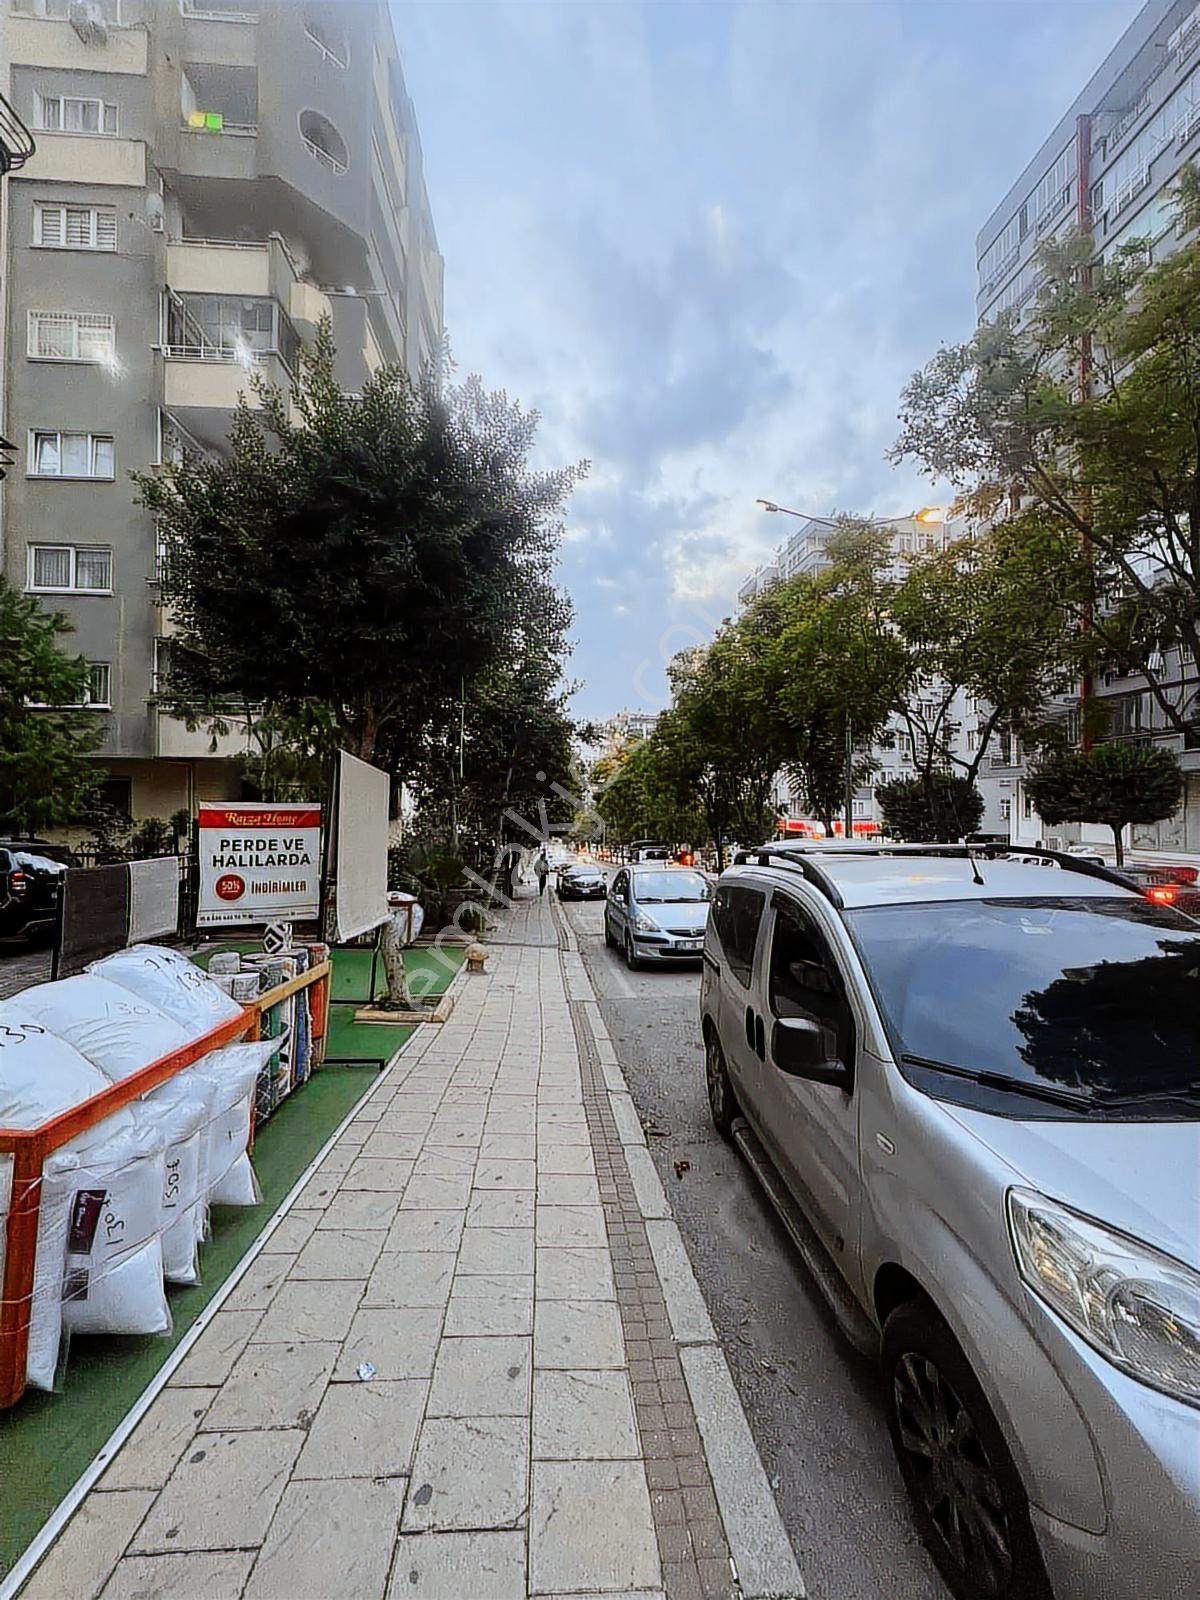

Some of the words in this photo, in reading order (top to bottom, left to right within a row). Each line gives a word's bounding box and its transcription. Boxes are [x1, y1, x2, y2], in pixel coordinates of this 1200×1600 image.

[220, 839, 278, 852] PERDE
[283, 838, 304, 851] VE
[212, 853, 311, 868] HALILARDA
[104, 1001, 151, 1017] 130
[0, 1024, 45, 1047] 30
